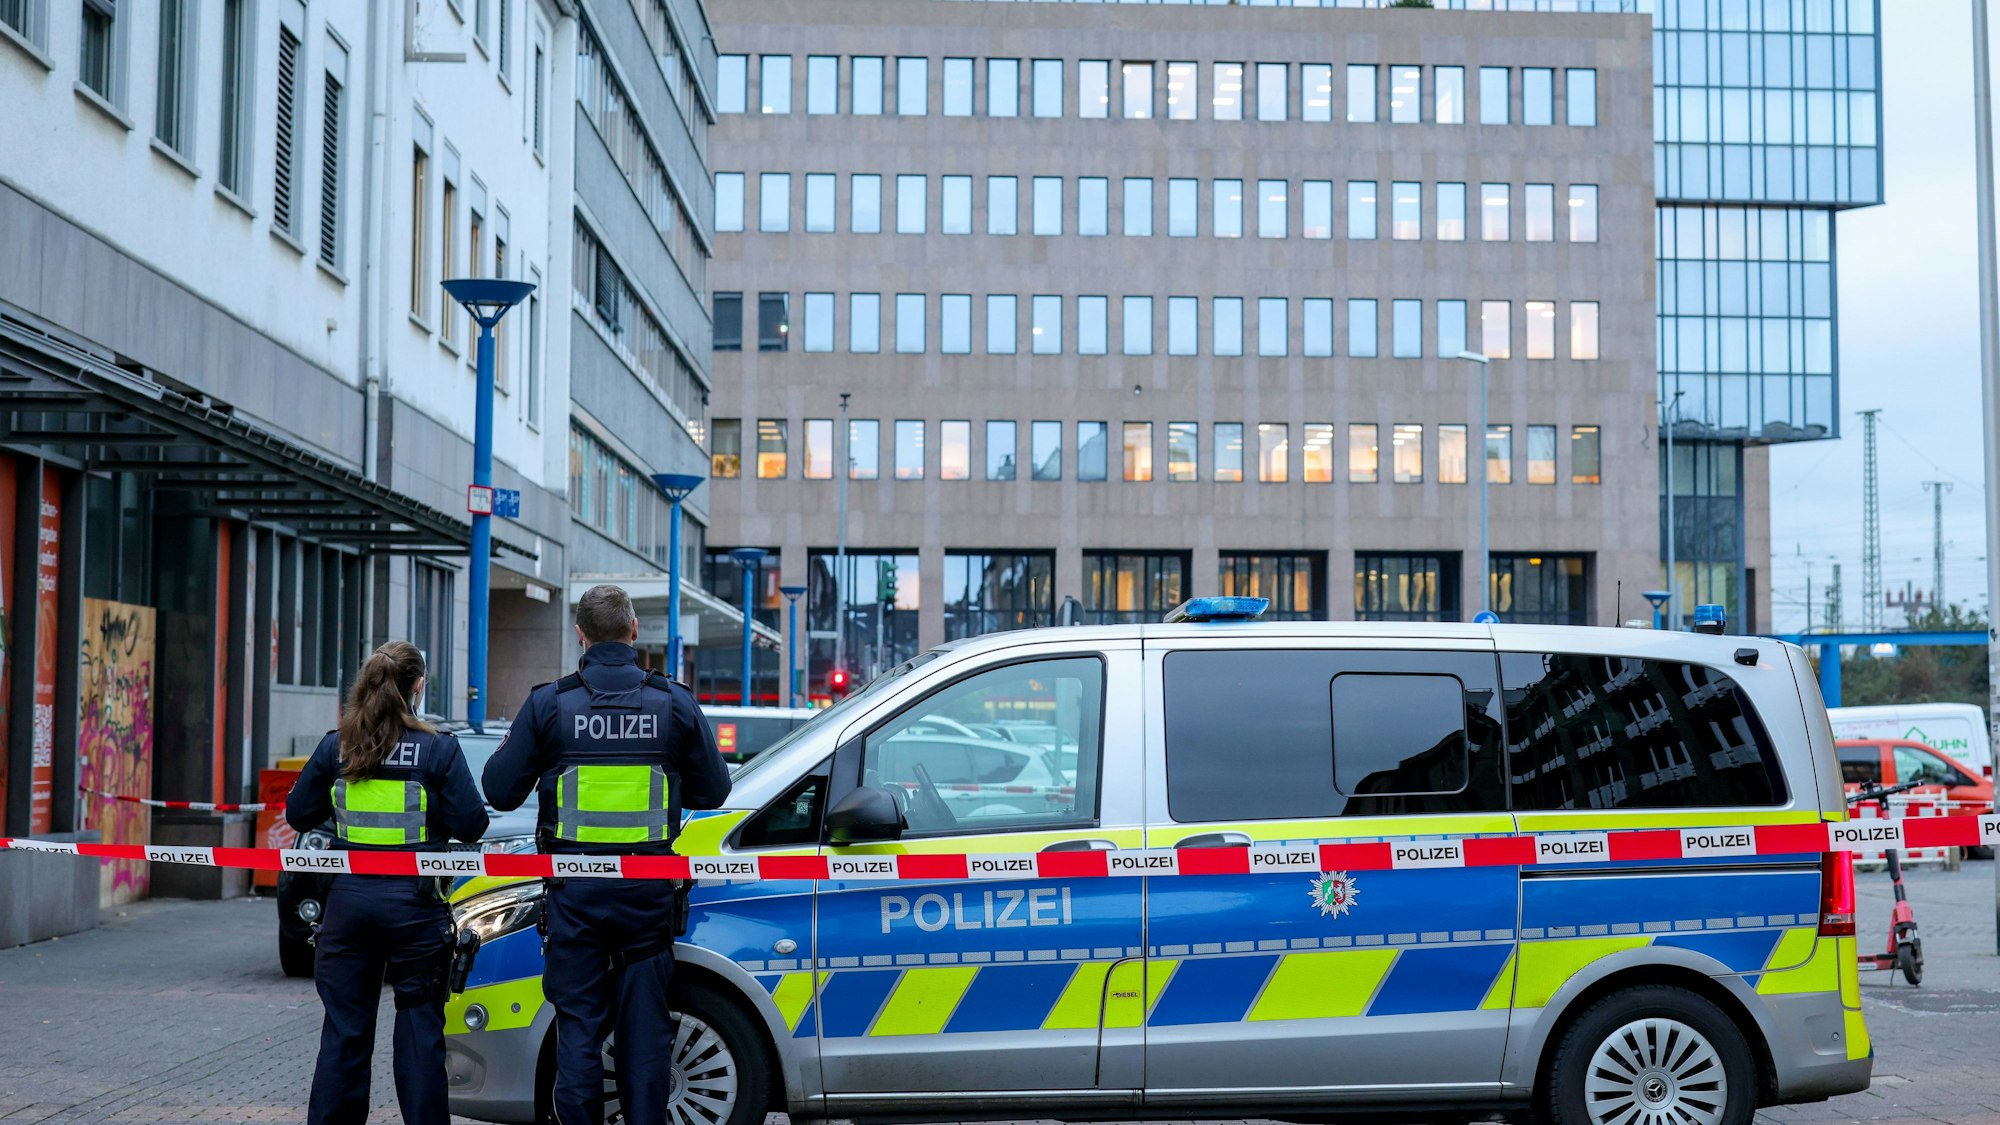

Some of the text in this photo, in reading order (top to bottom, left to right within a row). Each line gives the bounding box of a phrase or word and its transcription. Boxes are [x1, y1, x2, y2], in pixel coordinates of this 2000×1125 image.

[574, 714, 658, 740] POLIZEI
[150, 852, 209, 863] POLIZEI
[285, 856, 345, 868] POLIZEI
[420, 859, 481, 871] POLIZEI
[694, 863, 754, 874] POLIZEI
[832, 861, 893, 873] POLIZEI
[971, 859, 1033, 872] POLIZEI
[1112, 856, 1173, 869] POLIZEI
[1253, 852, 1315, 865] POLIZEI
[1396, 847, 1459, 861] POLIZEI
[1540, 840, 1604, 855] POLIZEI
[1686, 834, 1751, 849] POLIZEI
[1834, 827, 1900, 843] POLIZEI
[880, 887, 1073, 934] POLIZEI
